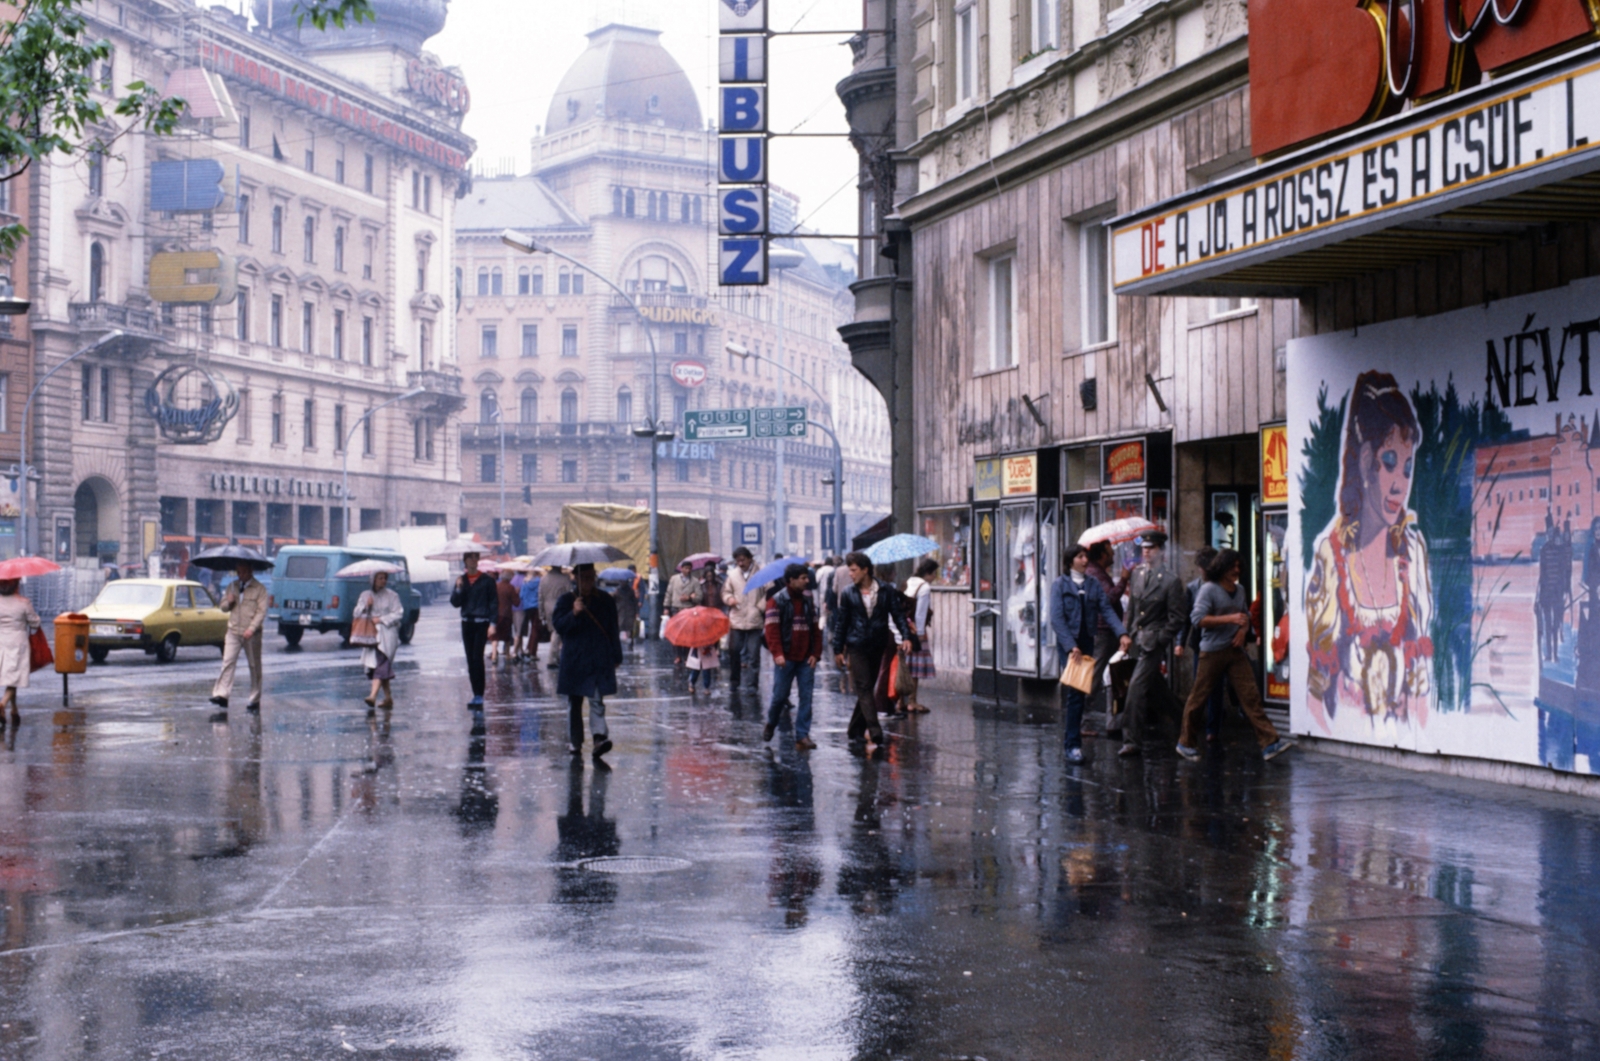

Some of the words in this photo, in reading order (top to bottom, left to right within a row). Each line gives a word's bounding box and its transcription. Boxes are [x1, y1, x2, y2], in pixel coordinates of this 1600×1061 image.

[286, 77, 328, 112] NAGY
[722, 36, 761, 283] IBUSZ
[1141, 218, 1165, 276] DE
[1176, 210, 1188, 266] A
[1243, 187, 1256, 246] A
[1264, 157, 1350, 240] ROSSZ
[1362, 141, 1399, 212] ÉS
[1412, 131, 1430, 198] A
[656, 442, 667, 458] 4
[671, 438, 716, 460] ÍZBEN
